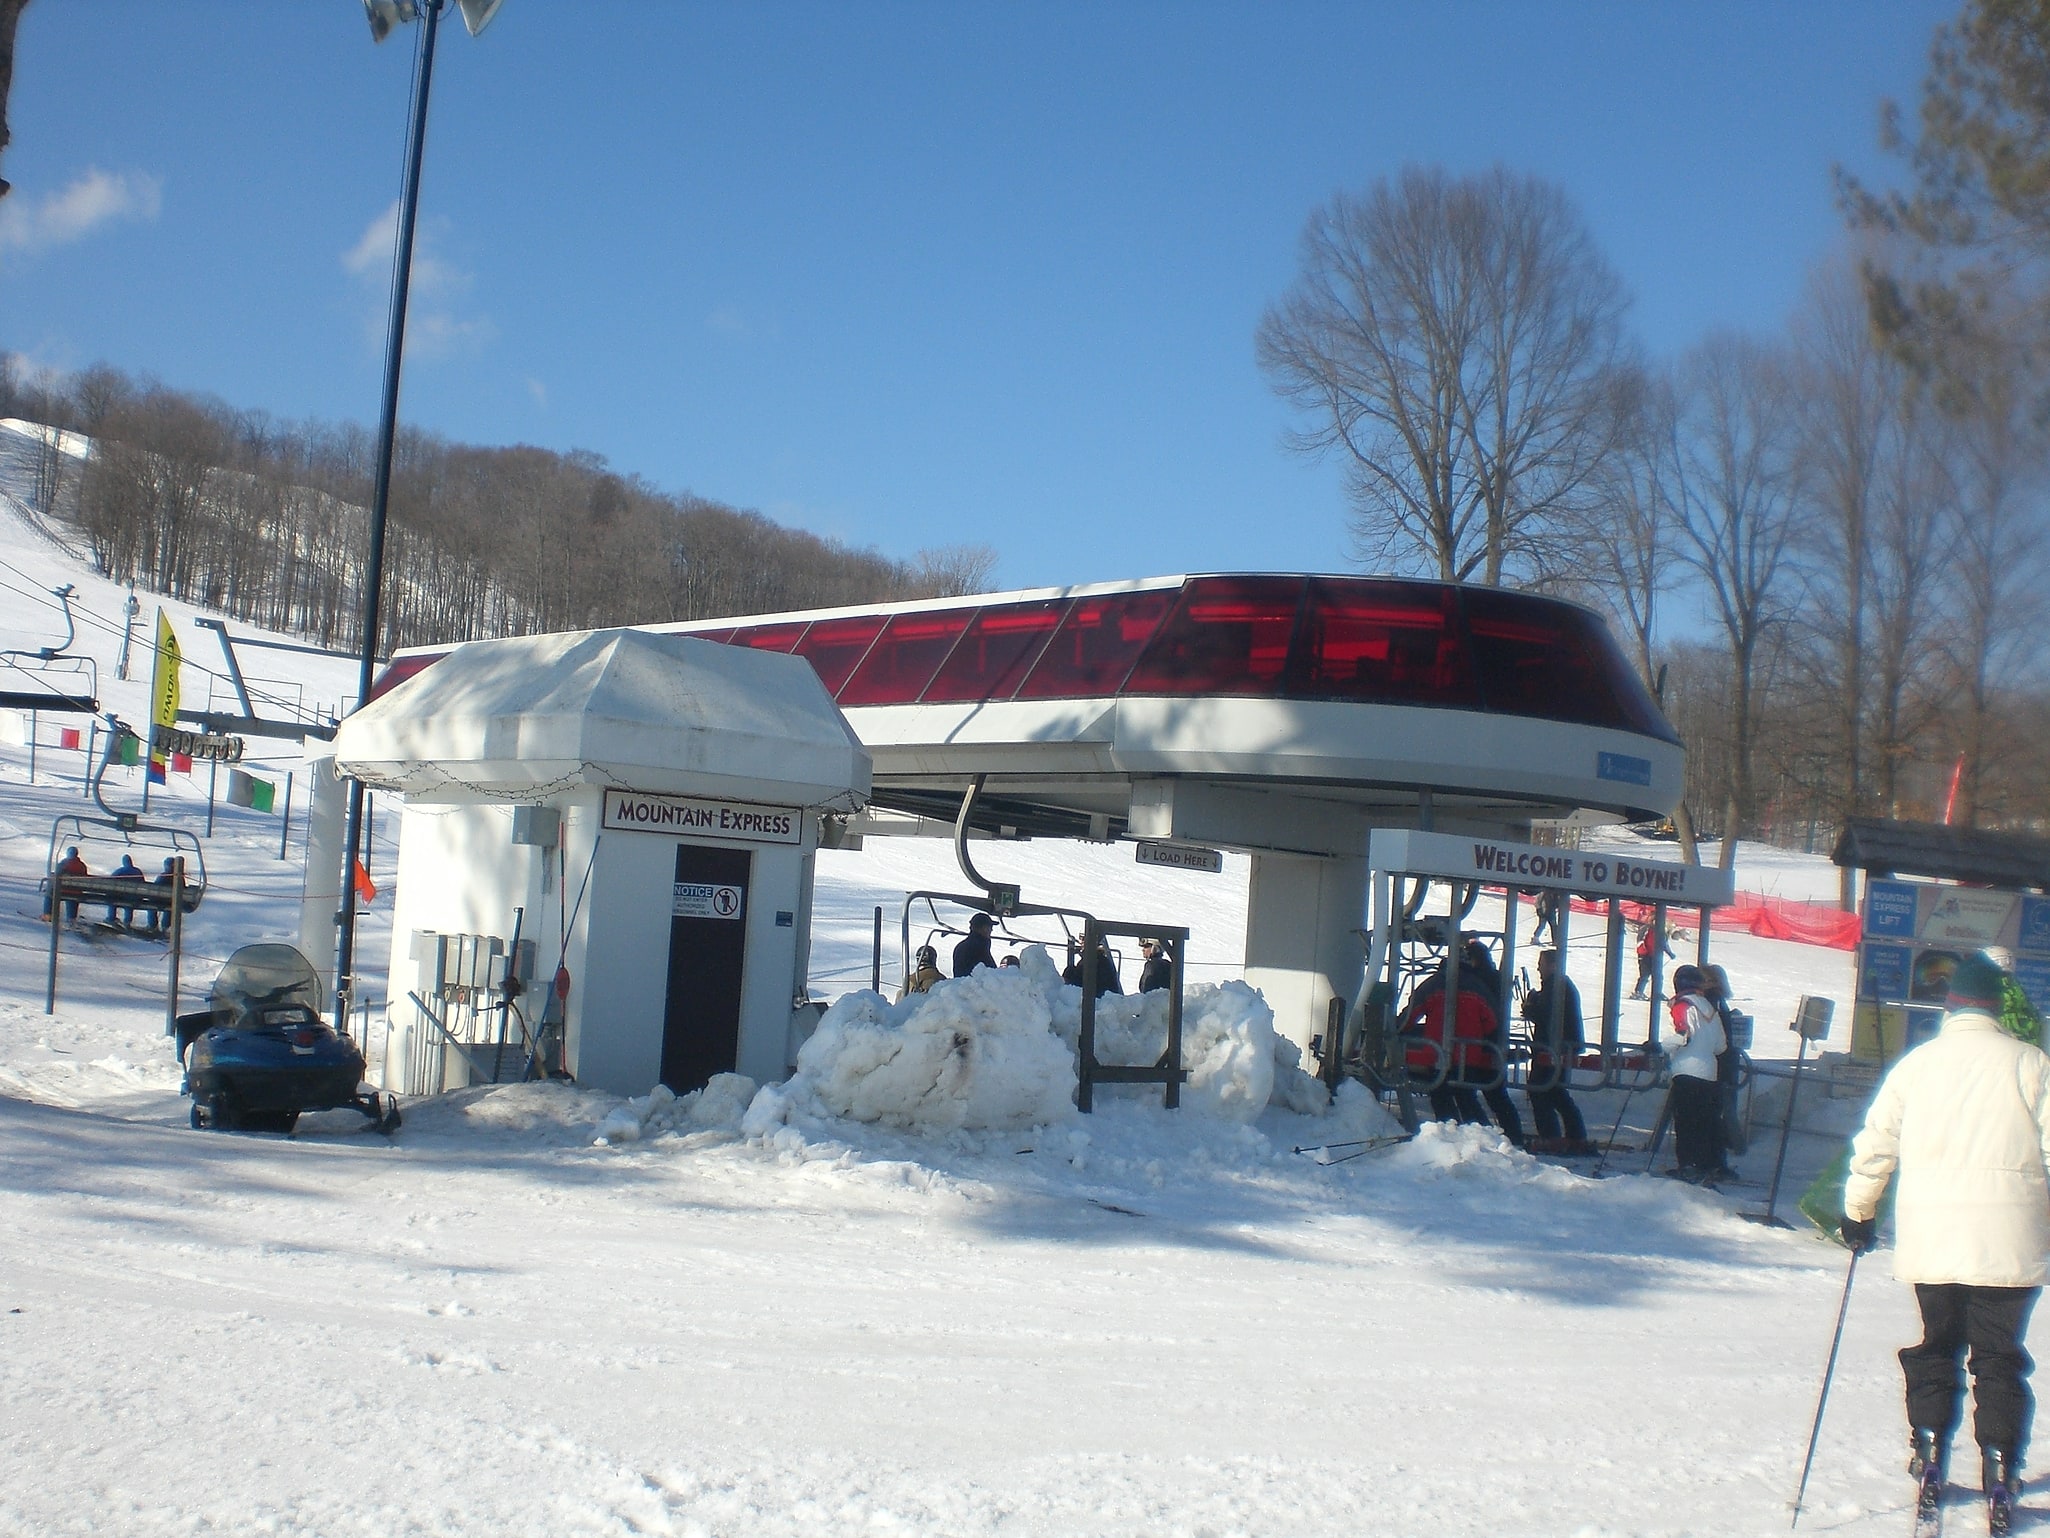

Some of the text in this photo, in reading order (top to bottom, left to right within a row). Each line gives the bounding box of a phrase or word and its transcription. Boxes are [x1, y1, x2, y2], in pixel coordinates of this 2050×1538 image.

[617, 799, 790, 835] MOUNTAIN EXPRESS
[1153, 850, 1207, 867] LOAD HERE
[1474, 844, 1686, 891] WELCOME TO BOYNE!
[674, 886, 712, 897] NOTICE
[1873, 892, 1913, 903] MOUNTAIN
[1874, 902, 1910, 914] EXPRESS
[1879, 915, 1901, 926] LIFT
